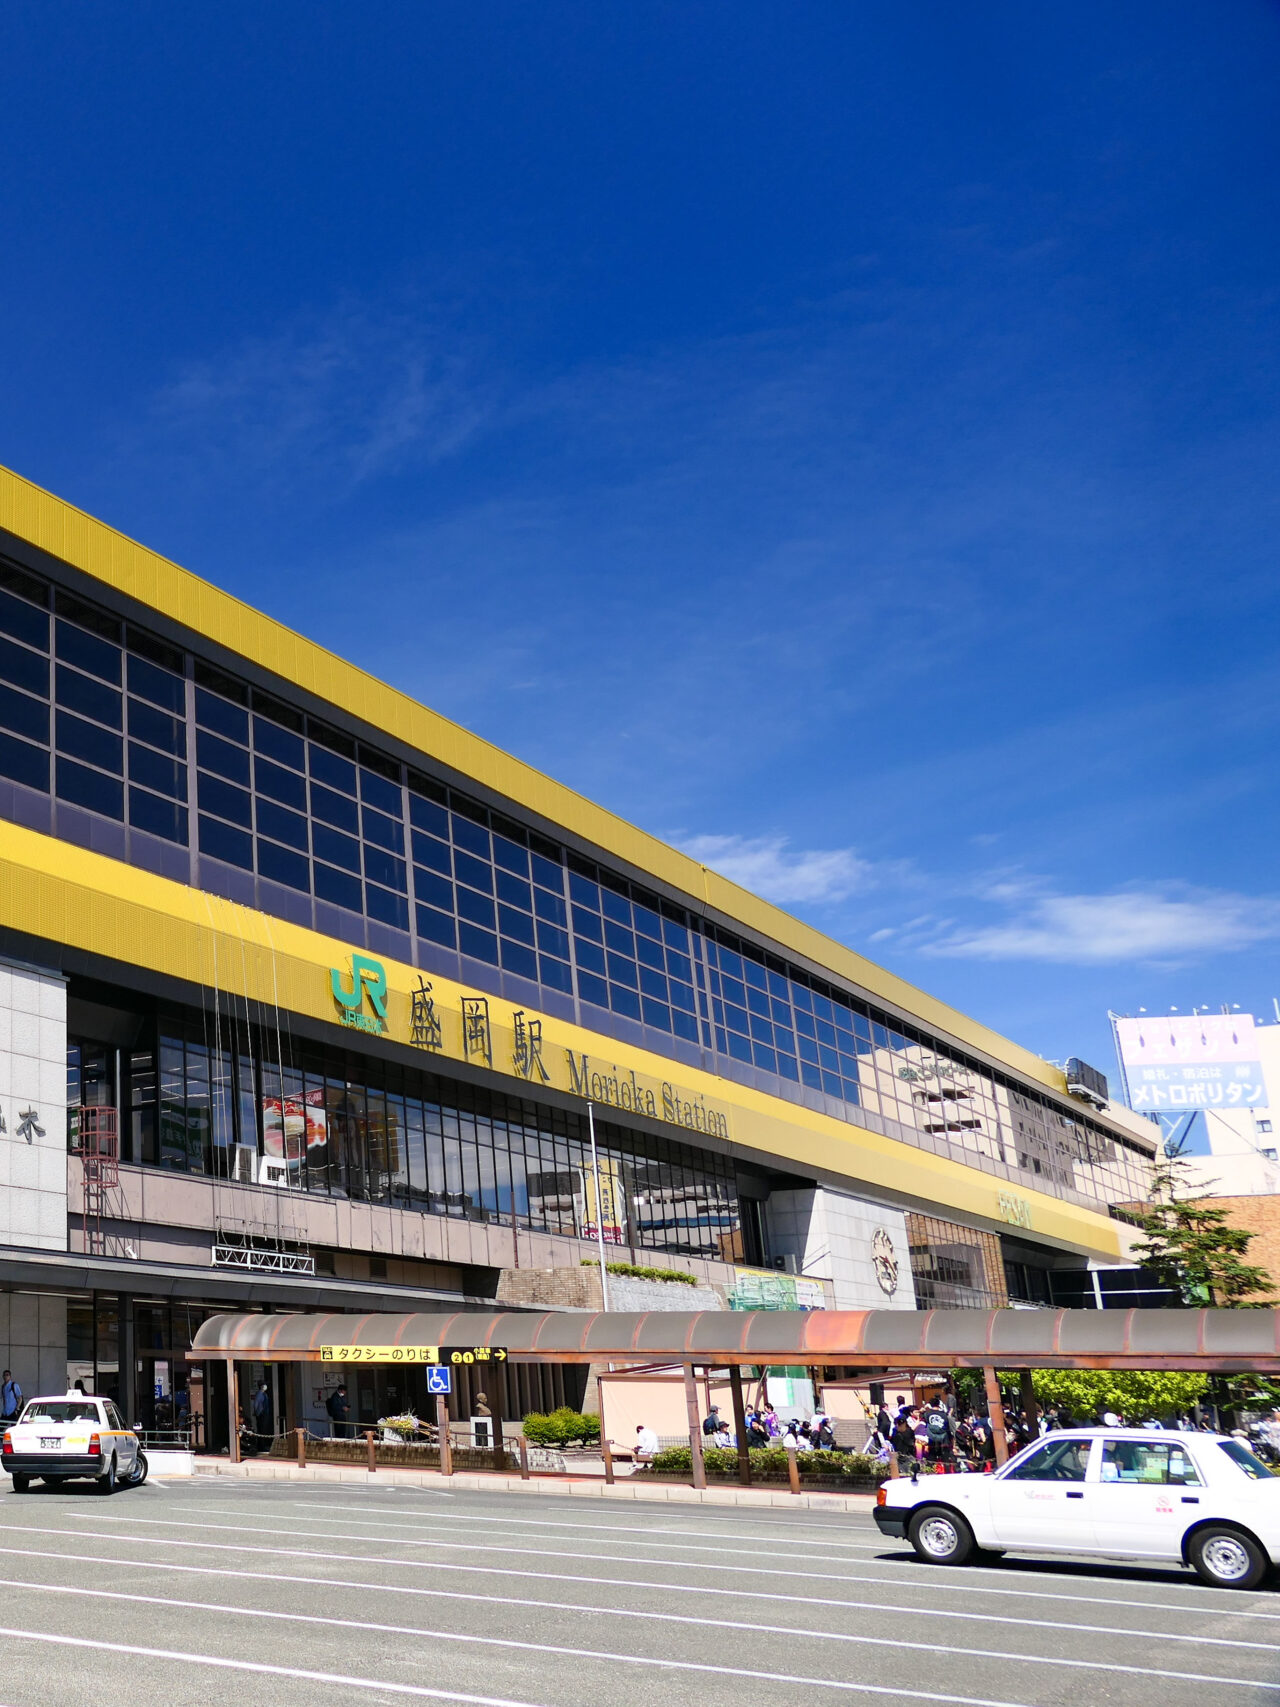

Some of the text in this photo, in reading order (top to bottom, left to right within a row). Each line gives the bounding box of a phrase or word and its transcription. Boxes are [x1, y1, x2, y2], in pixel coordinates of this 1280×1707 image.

[330, 953, 388, 1018] JR
[340, 1009, 383, 1035] JR東日本
[409, 974, 551, 1081] 盛岡駅
[566, 1049, 729, 1139] Morioka Station
[1134, 1082, 1262, 1105] メトロポリタン
[339, 1348, 432, 1361] タクシーのりば
